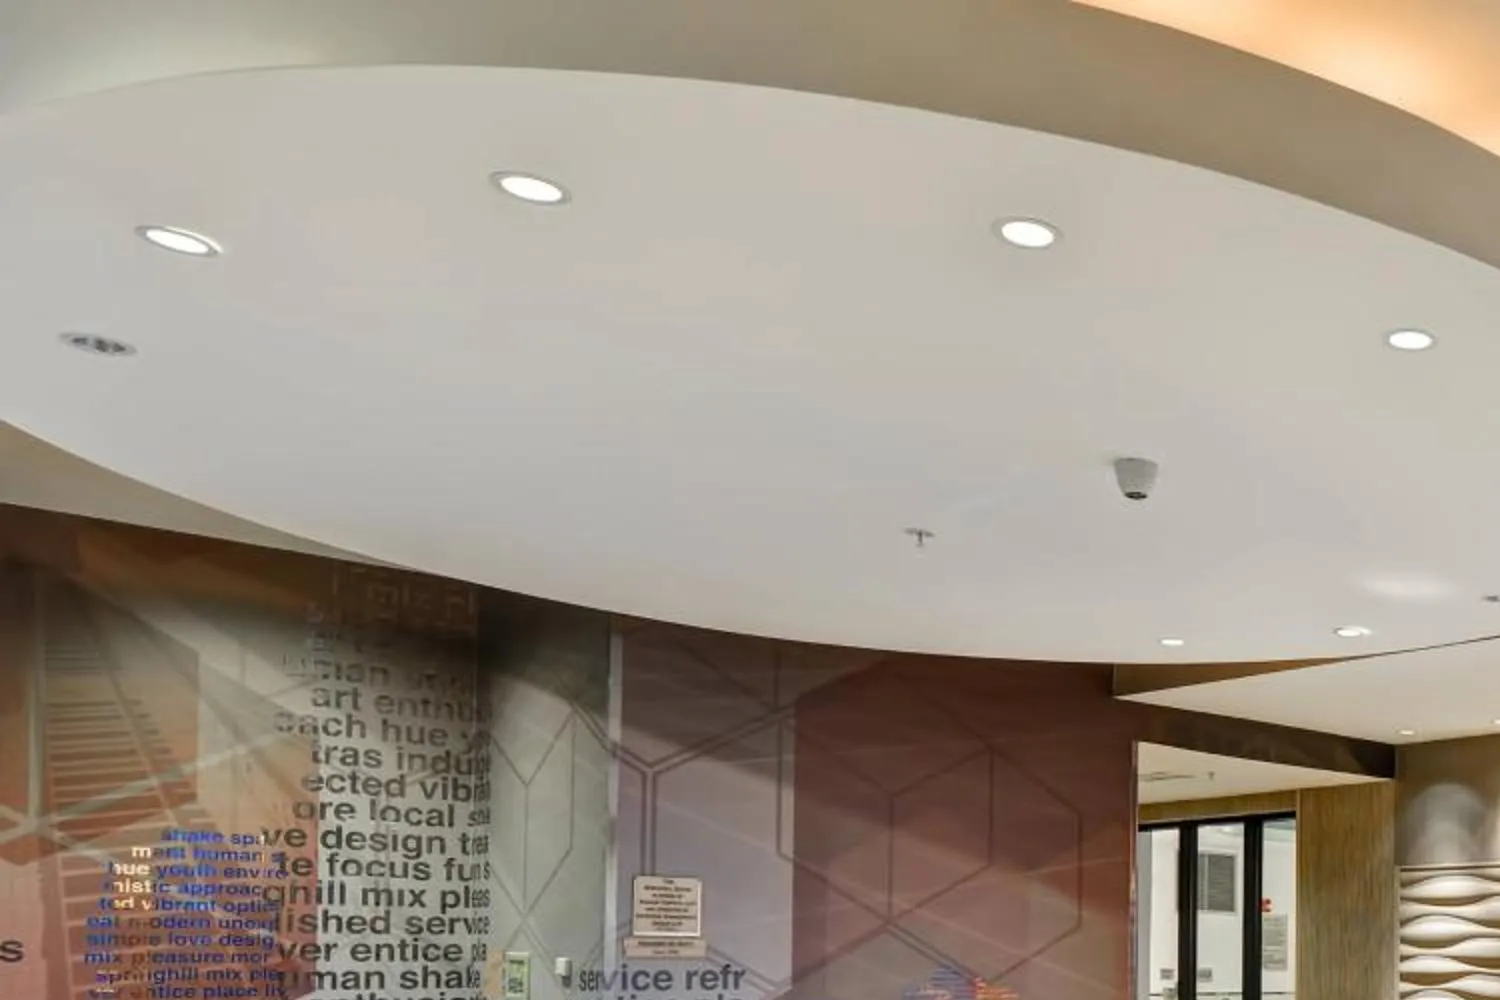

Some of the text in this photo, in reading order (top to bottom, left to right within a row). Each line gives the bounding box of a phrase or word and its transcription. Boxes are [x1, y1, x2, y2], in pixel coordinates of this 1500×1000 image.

[311, 687, 362, 711] art
[381, 718, 449, 747] hue
[303, 770, 406, 799] ected
[293, 799, 455, 828] ore local
[320, 825, 446, 860] design
[326, 852, 432, 881] focus
[361, 885, 427, 908] mix
[405, 912, 490, 936] service
[350, 938, 464, 963] entice
[578, 962, 674, 992] service
